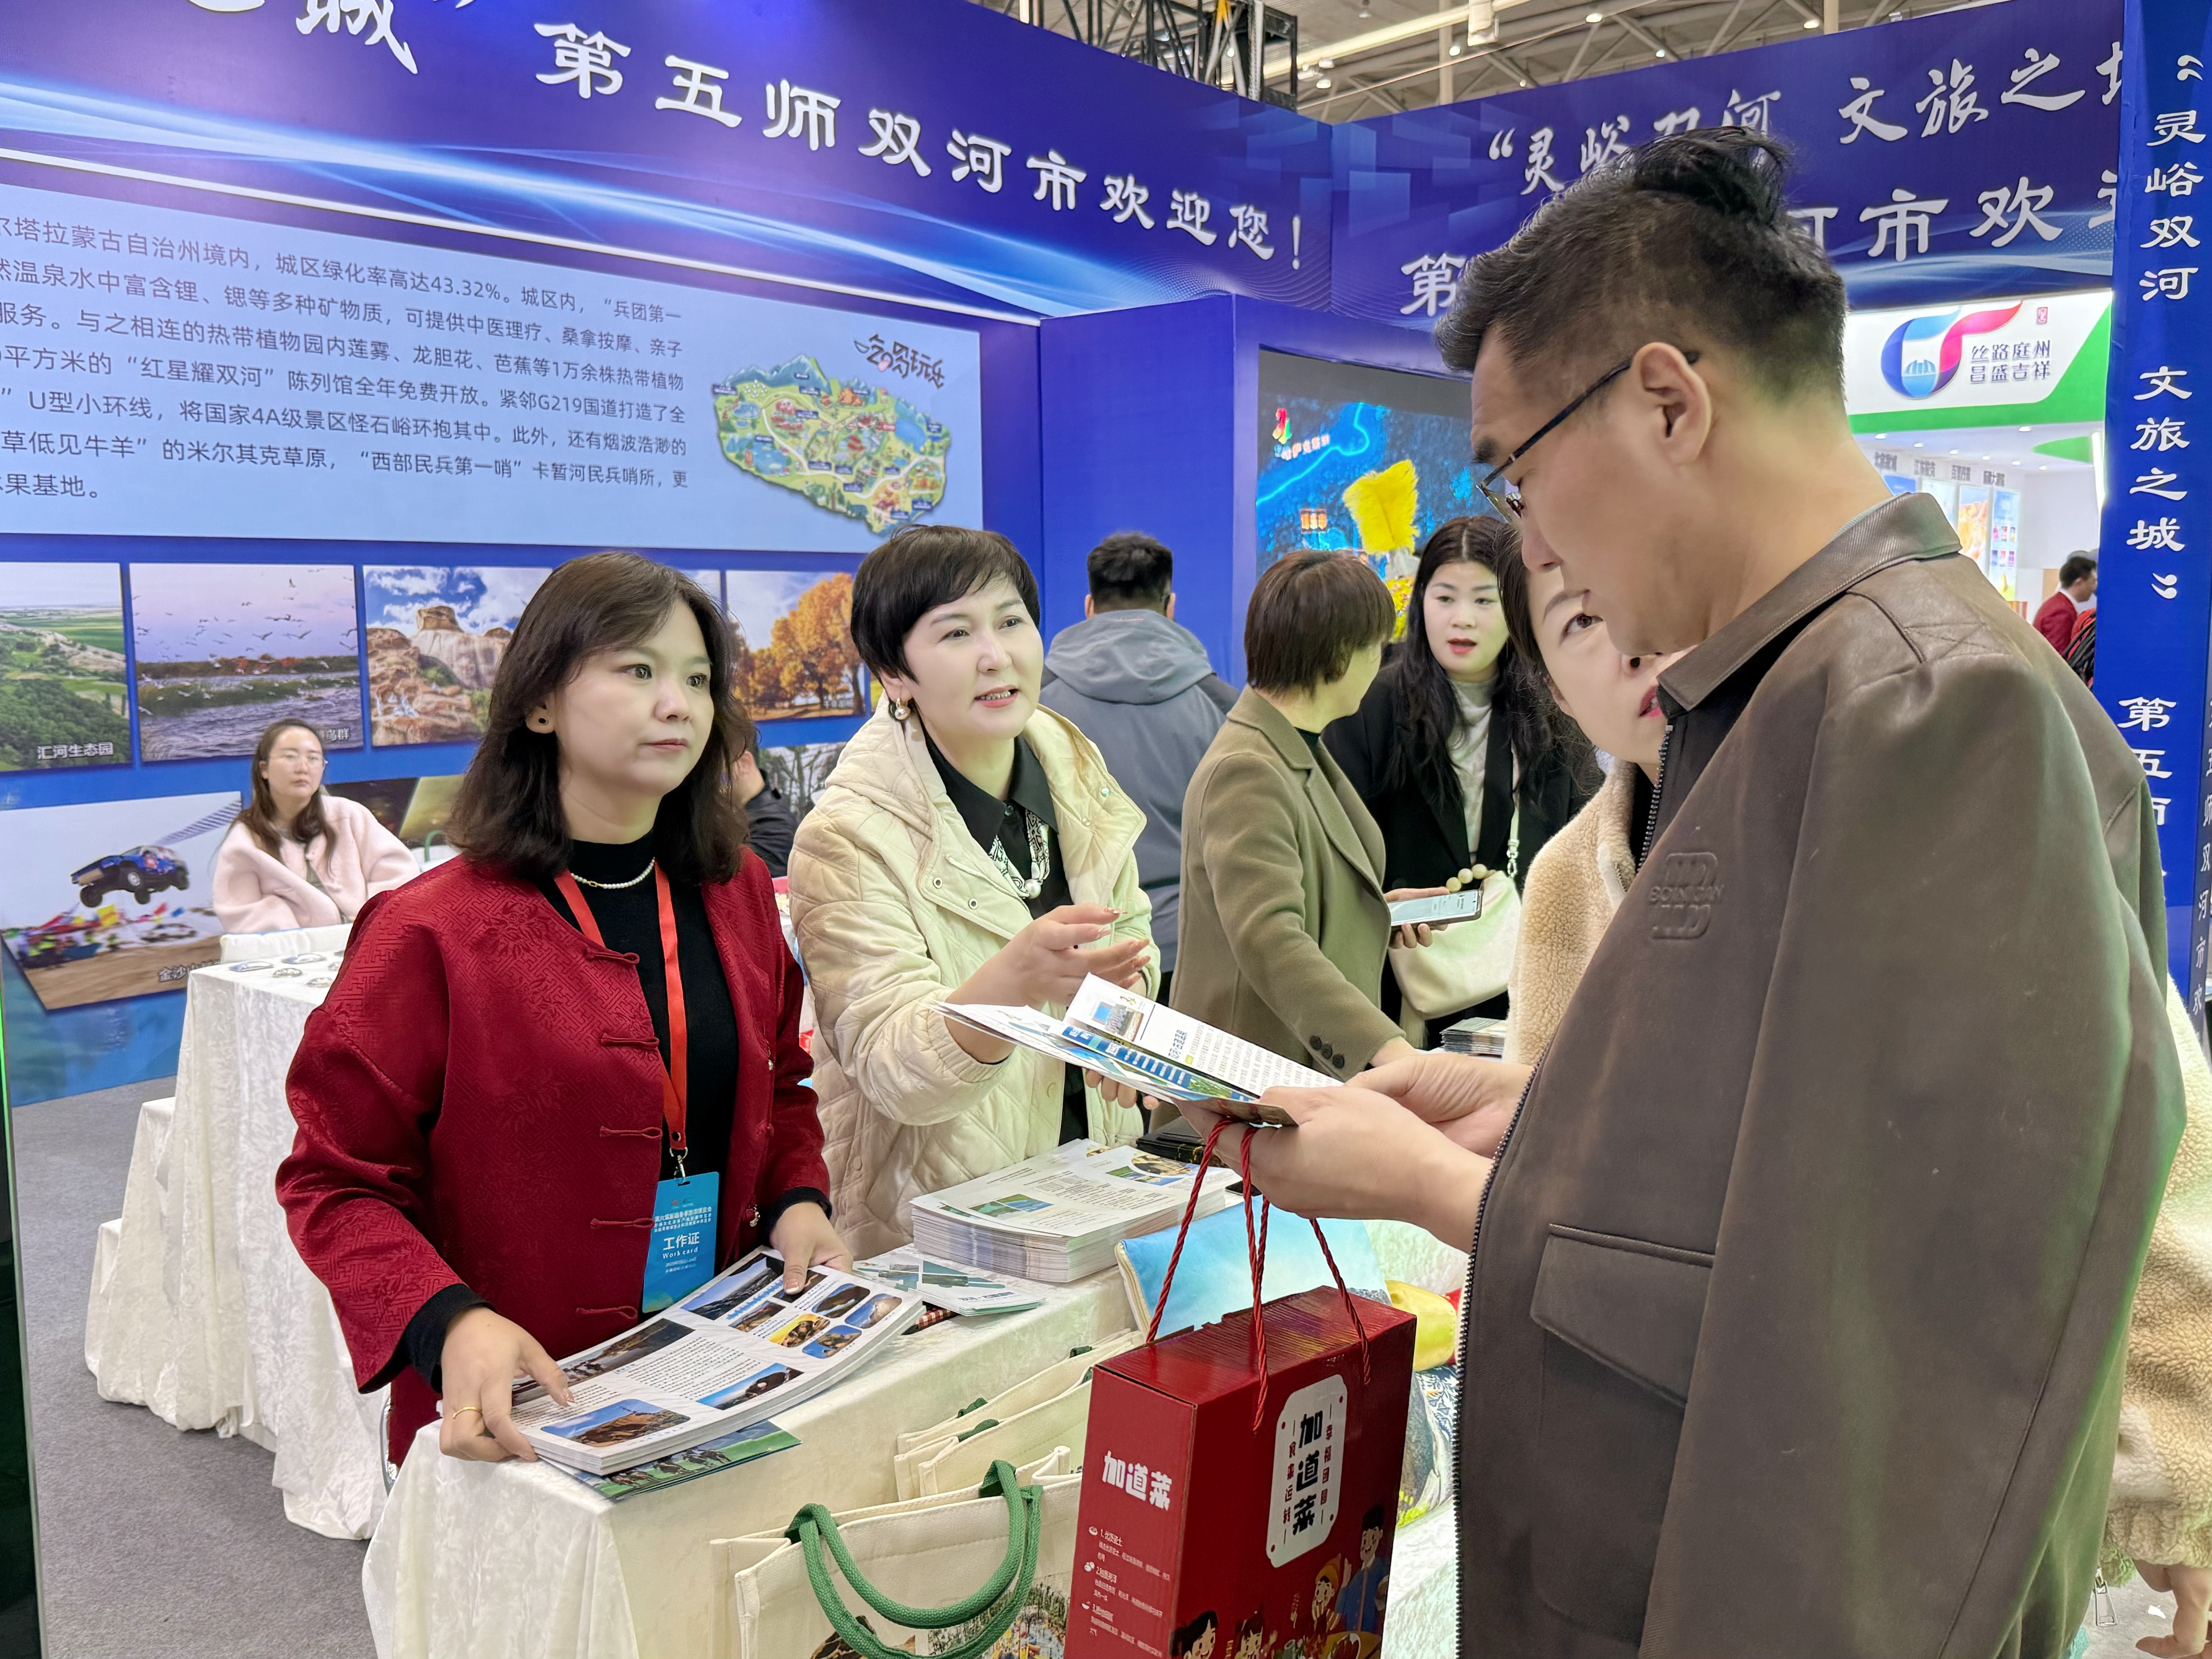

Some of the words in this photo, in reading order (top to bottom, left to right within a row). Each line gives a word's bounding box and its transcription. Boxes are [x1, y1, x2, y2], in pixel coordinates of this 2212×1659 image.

[1971, 340, 2051, 363] 丝路庭州
[1970, 361, 2051, 383] 昌盛吉祥
[0, 346, 685, 424] 平方米的“红星耀双河”陈列馆全年免费开放。紧邻G219国道打造了全
[0, 474, 98, 499] 果基地。
[37, 742, 113, 759] 汇河生态园
[2117, 697, 2176, 876] 第五
[663, 1231, 700, 1251] 工作证
[663, 1250, 680, 1259] Work
[682, 1247, 698, 1255] card
[1102, 1450, 1172, 1511] 加道菜
[1292, 1410, 1323, 1536] 加道菜
